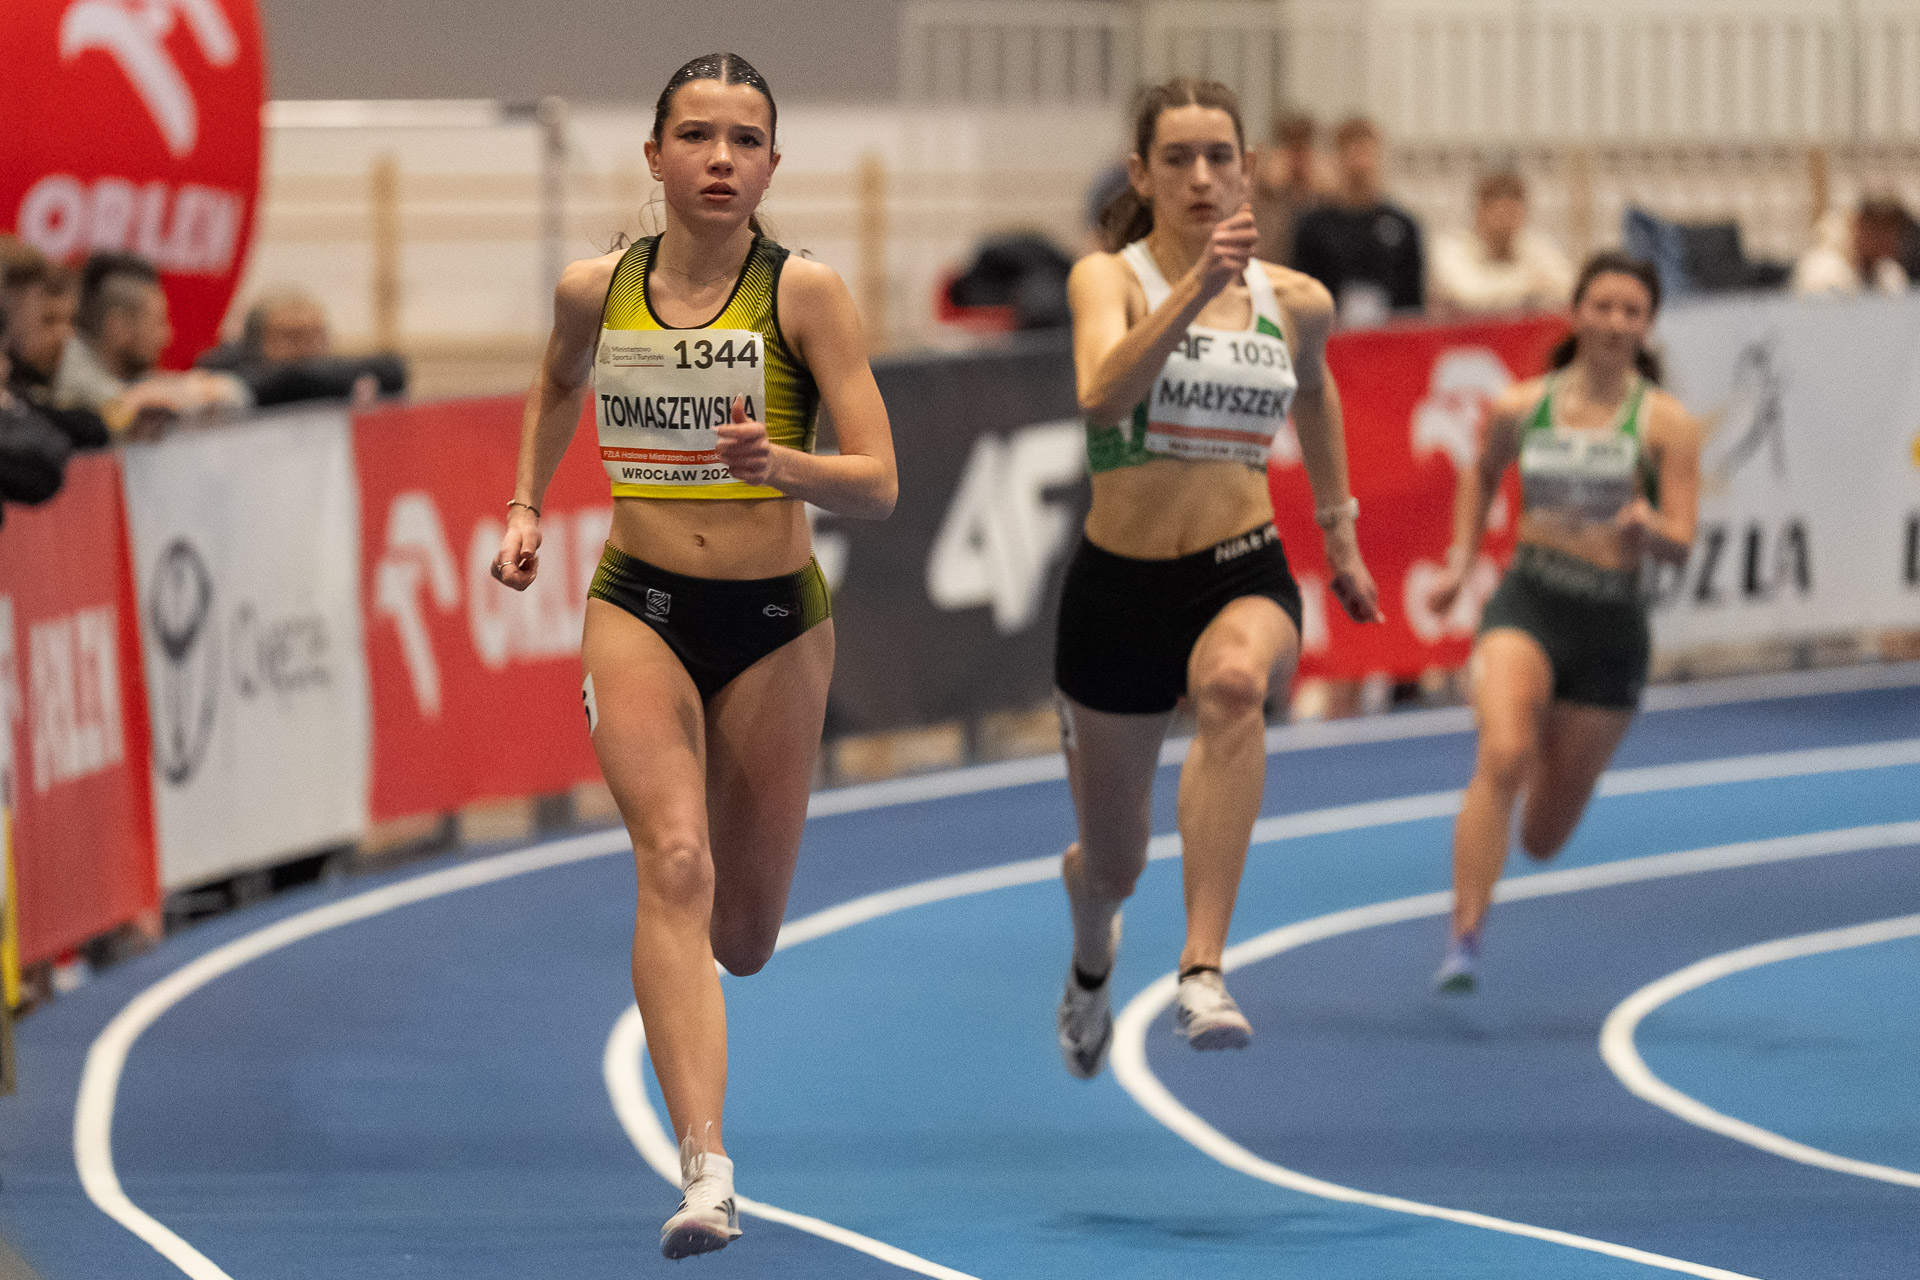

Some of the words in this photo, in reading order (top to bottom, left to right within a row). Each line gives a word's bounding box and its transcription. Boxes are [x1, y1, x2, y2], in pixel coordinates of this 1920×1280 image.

[673, 340, 759, 369] 1344
[1229, 341, 1288, 370] 1033
[1159, 379, 1288, 418] MAŁYSZEK
[621, 451, 648, 460] Halowe
[648, 453, 696, 463] Mistrzostwa
[697, 454, 721, 462] Polsk
[622, 467, 697, 481] WROCŁAW
[701, 467, 731, 481] 202
[926, 418, 1092, 636] 4F
